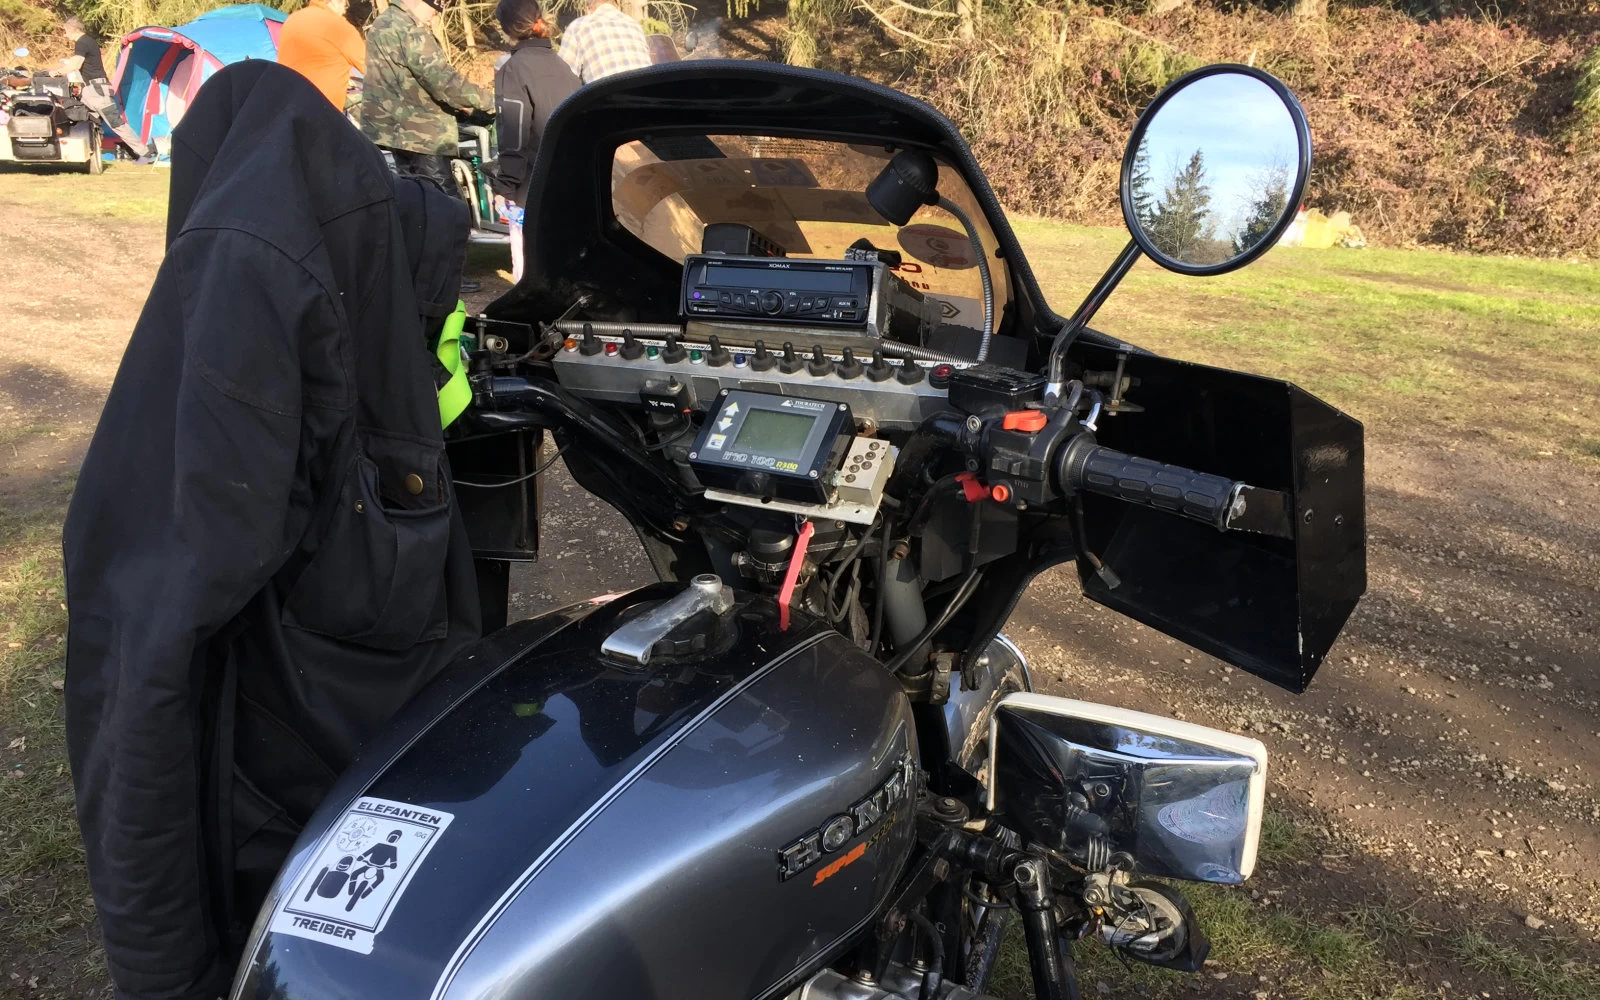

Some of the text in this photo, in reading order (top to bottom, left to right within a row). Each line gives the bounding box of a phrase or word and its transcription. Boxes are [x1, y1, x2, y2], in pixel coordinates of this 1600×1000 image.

[794, 400, 826, 409] TOURATECH
[357, 801, 442, 825] ELEFANTEN
[291, 916, 357, 941] TREIBER
